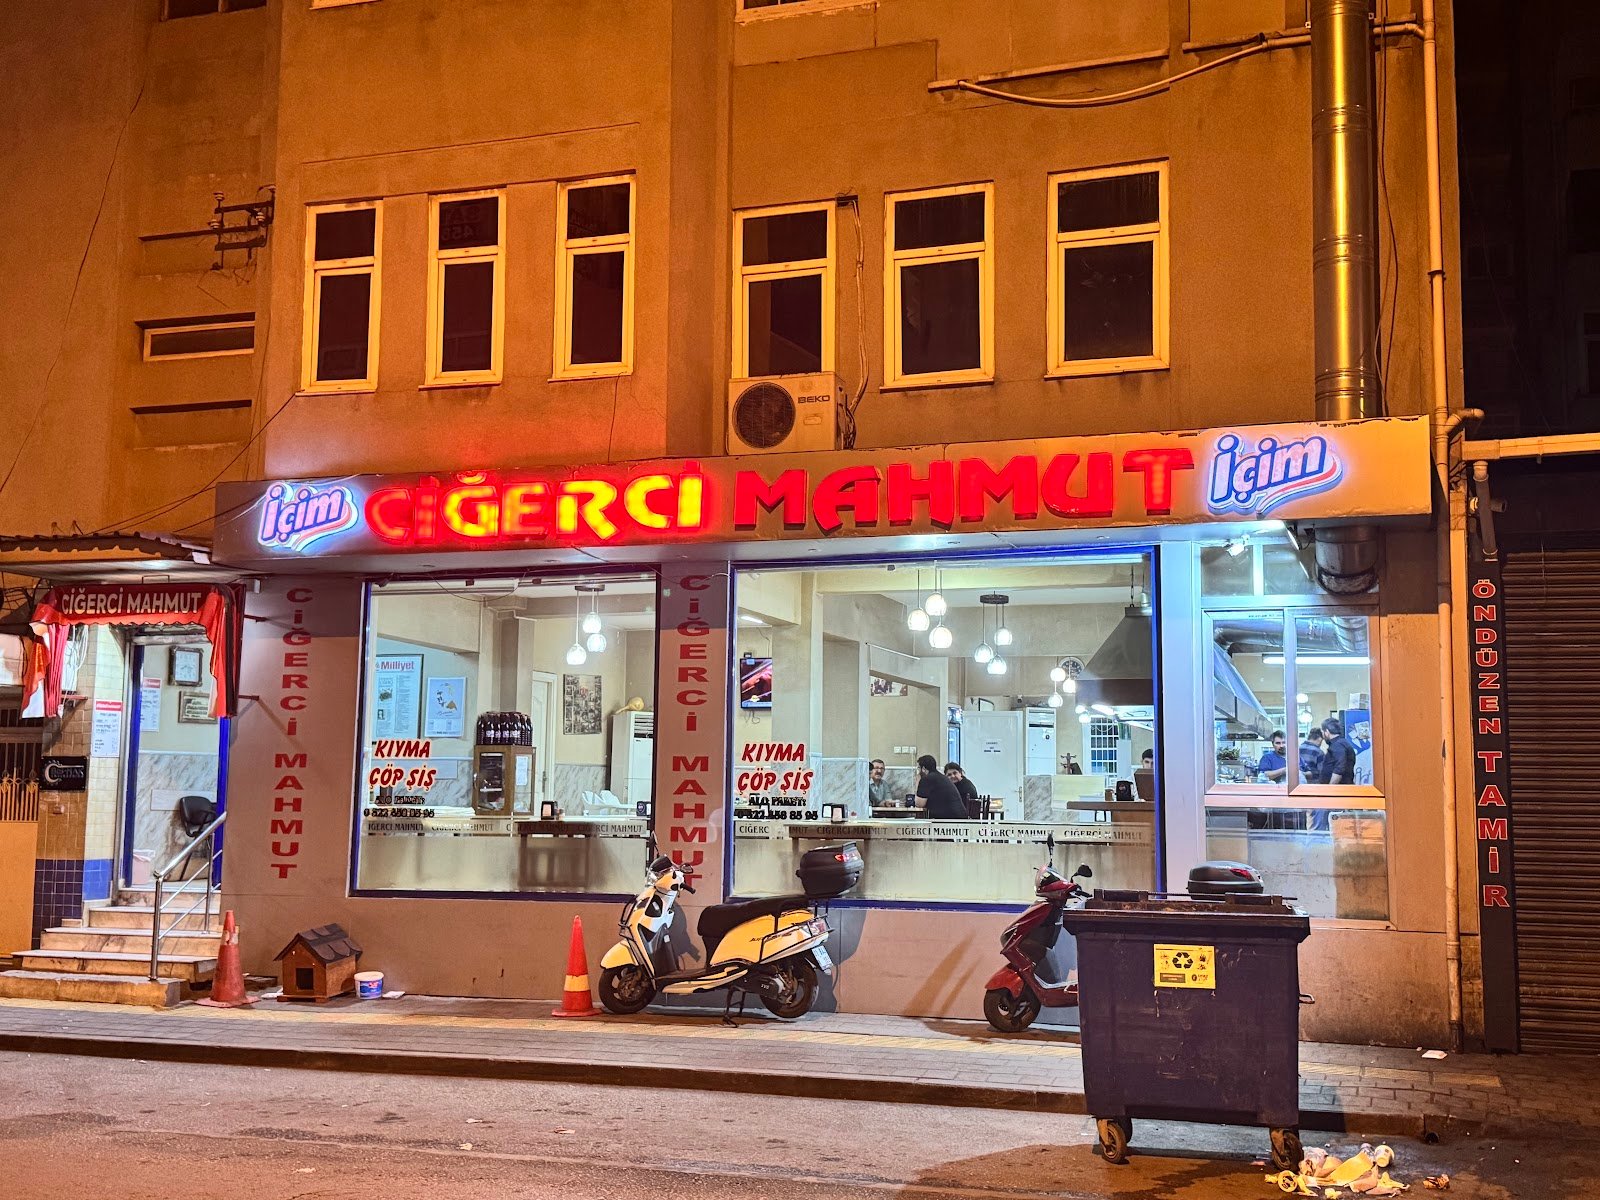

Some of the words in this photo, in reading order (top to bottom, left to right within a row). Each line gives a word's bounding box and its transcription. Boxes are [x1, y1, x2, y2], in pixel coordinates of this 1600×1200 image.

[798, 395, 830, 404] BEKO
[1210, 434, 1327, 504] İçim
[364, 460, 704, 545] CİĞERCİ
[733, 447, 1195, 534] MAHMUT
[258, 481, 348, 544] İçim
[61, 586, 125, 615] CİĞERCİ
[126, 592, 202, 614] MAHMUT
[280, 588, 314, 736] CİĞERCİ
[380, 660, 415, 672] Milliyet
[676, 574, 711, 732] CİĞERCİ
[1472, 578, 1502, 735] ÖNDÜZEN
[374, 739, 431, 758] KIYMA
[741, 743, 805, 763] KIYMA
[369, 764, 404, 790] ÇÖP
[407, 764, 437, 792] ŞİŞ
[737, 767, 777, 795] ÇÖP
[780, 767, 814, 795] ŞİŞ
[270, 753, 308, 879] MAHMUT
[739, 824, 771, 836] CİĞERC
[1477, 751, 1510, 908] TAMİR
[934, 827, 971, 838] MAHMUT
